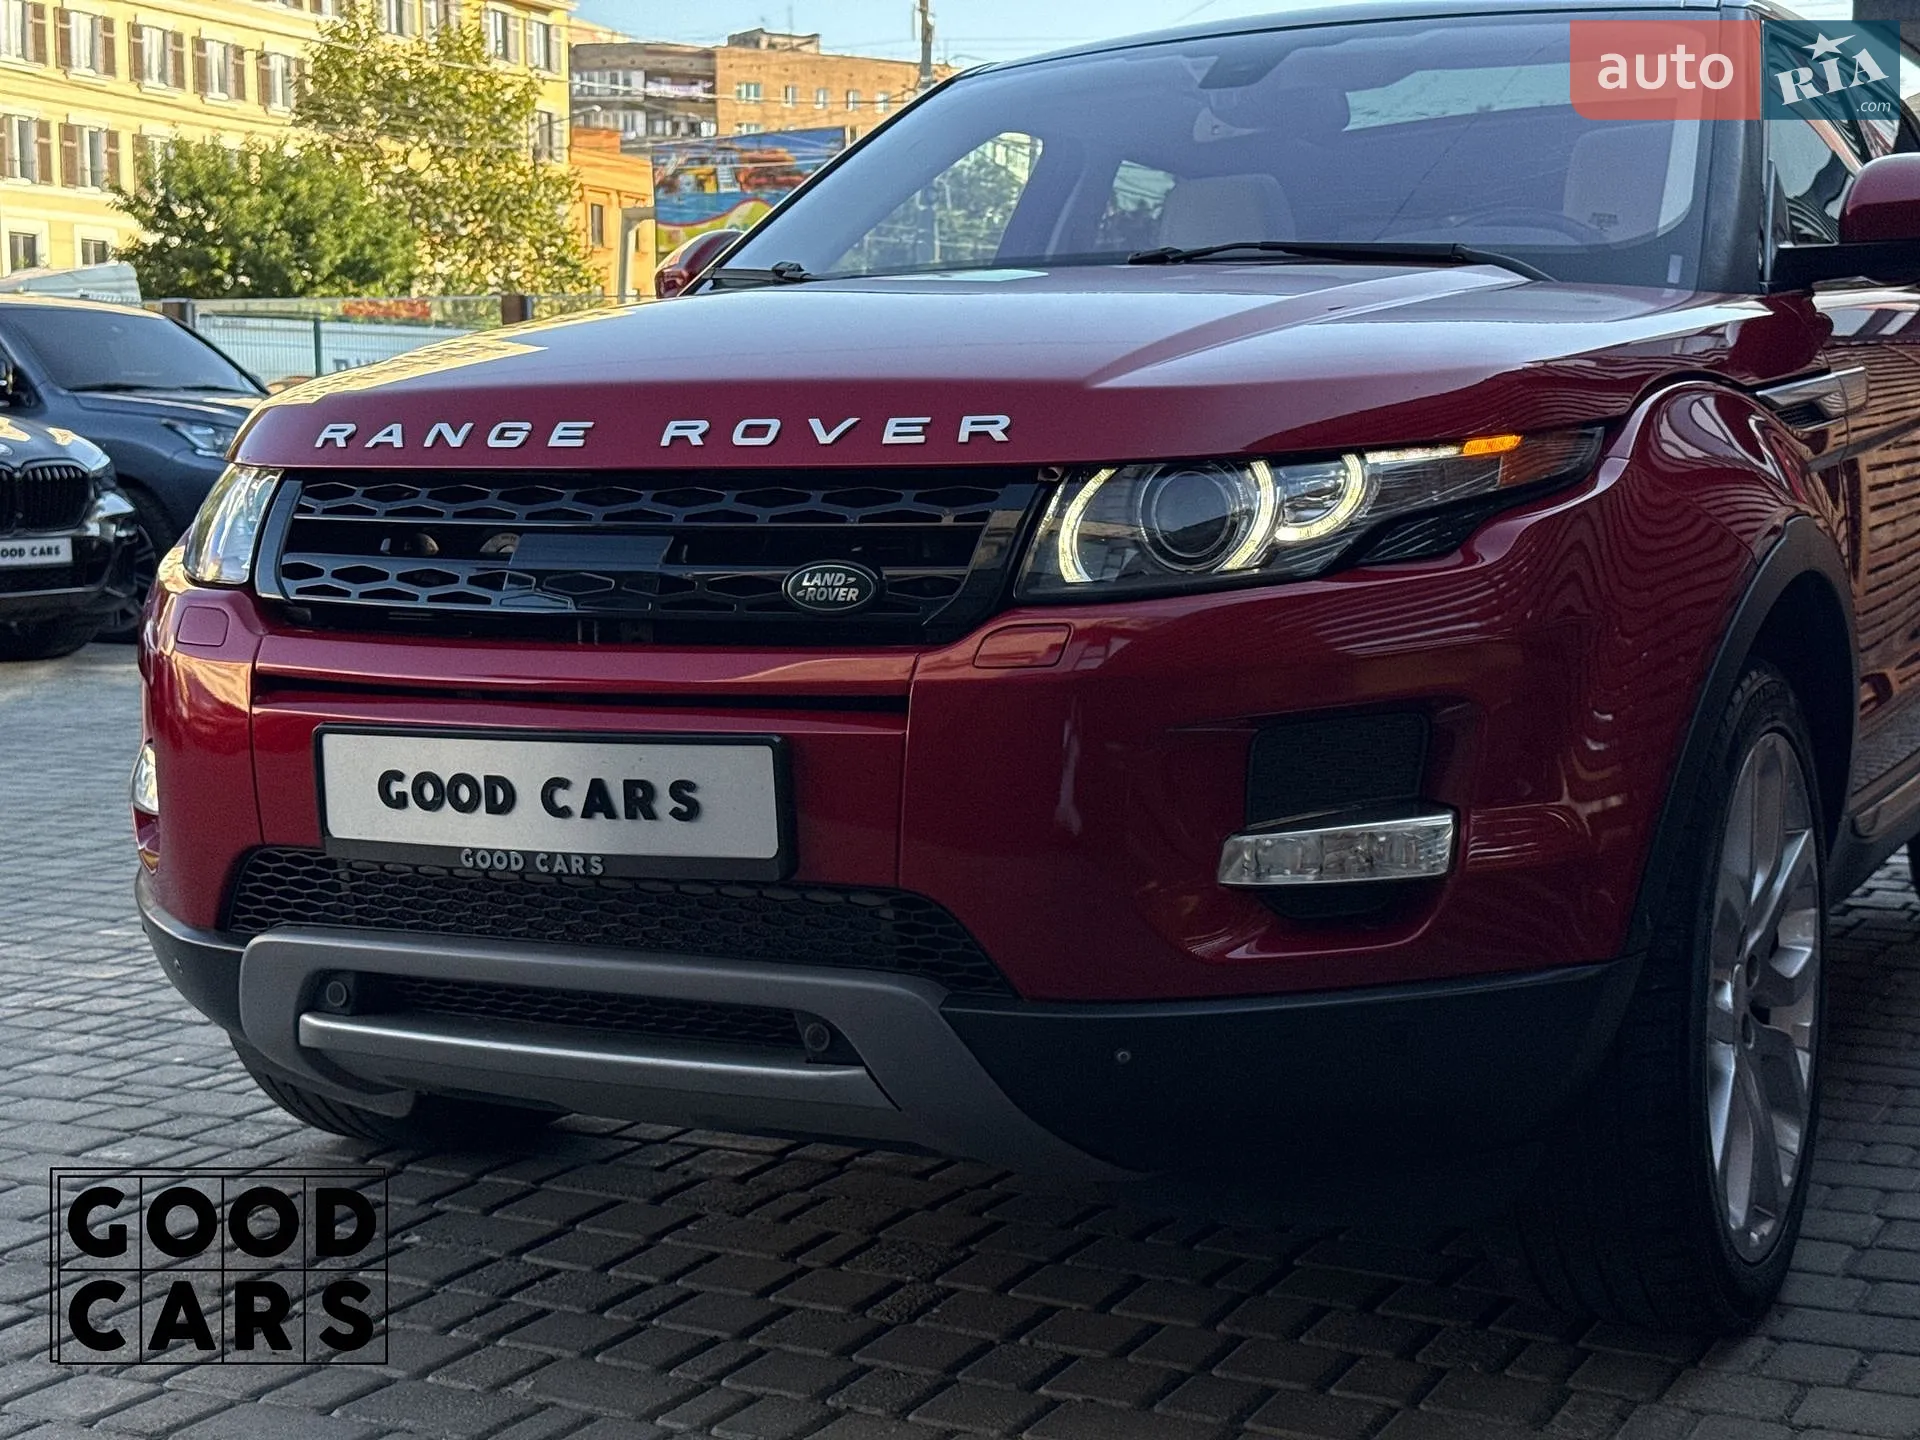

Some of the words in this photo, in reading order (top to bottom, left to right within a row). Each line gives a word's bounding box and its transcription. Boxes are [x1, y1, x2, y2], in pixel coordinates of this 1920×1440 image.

[314, 421, 595, 449] RANGE
[660, 414, 1012, 447] ROVER
[0, 547, 26, 558] OOD
[30, 545, 61, 557] CARS
[802, 572, 846, 586] LAND
[805, 587, 860, 602] ROVER
[377, 769, 517, 816] GOOD
[540, 776, 702, 822] CARS
[460, 848, 525, 871] GOOD
[535, 853, 604, 876] CARS
